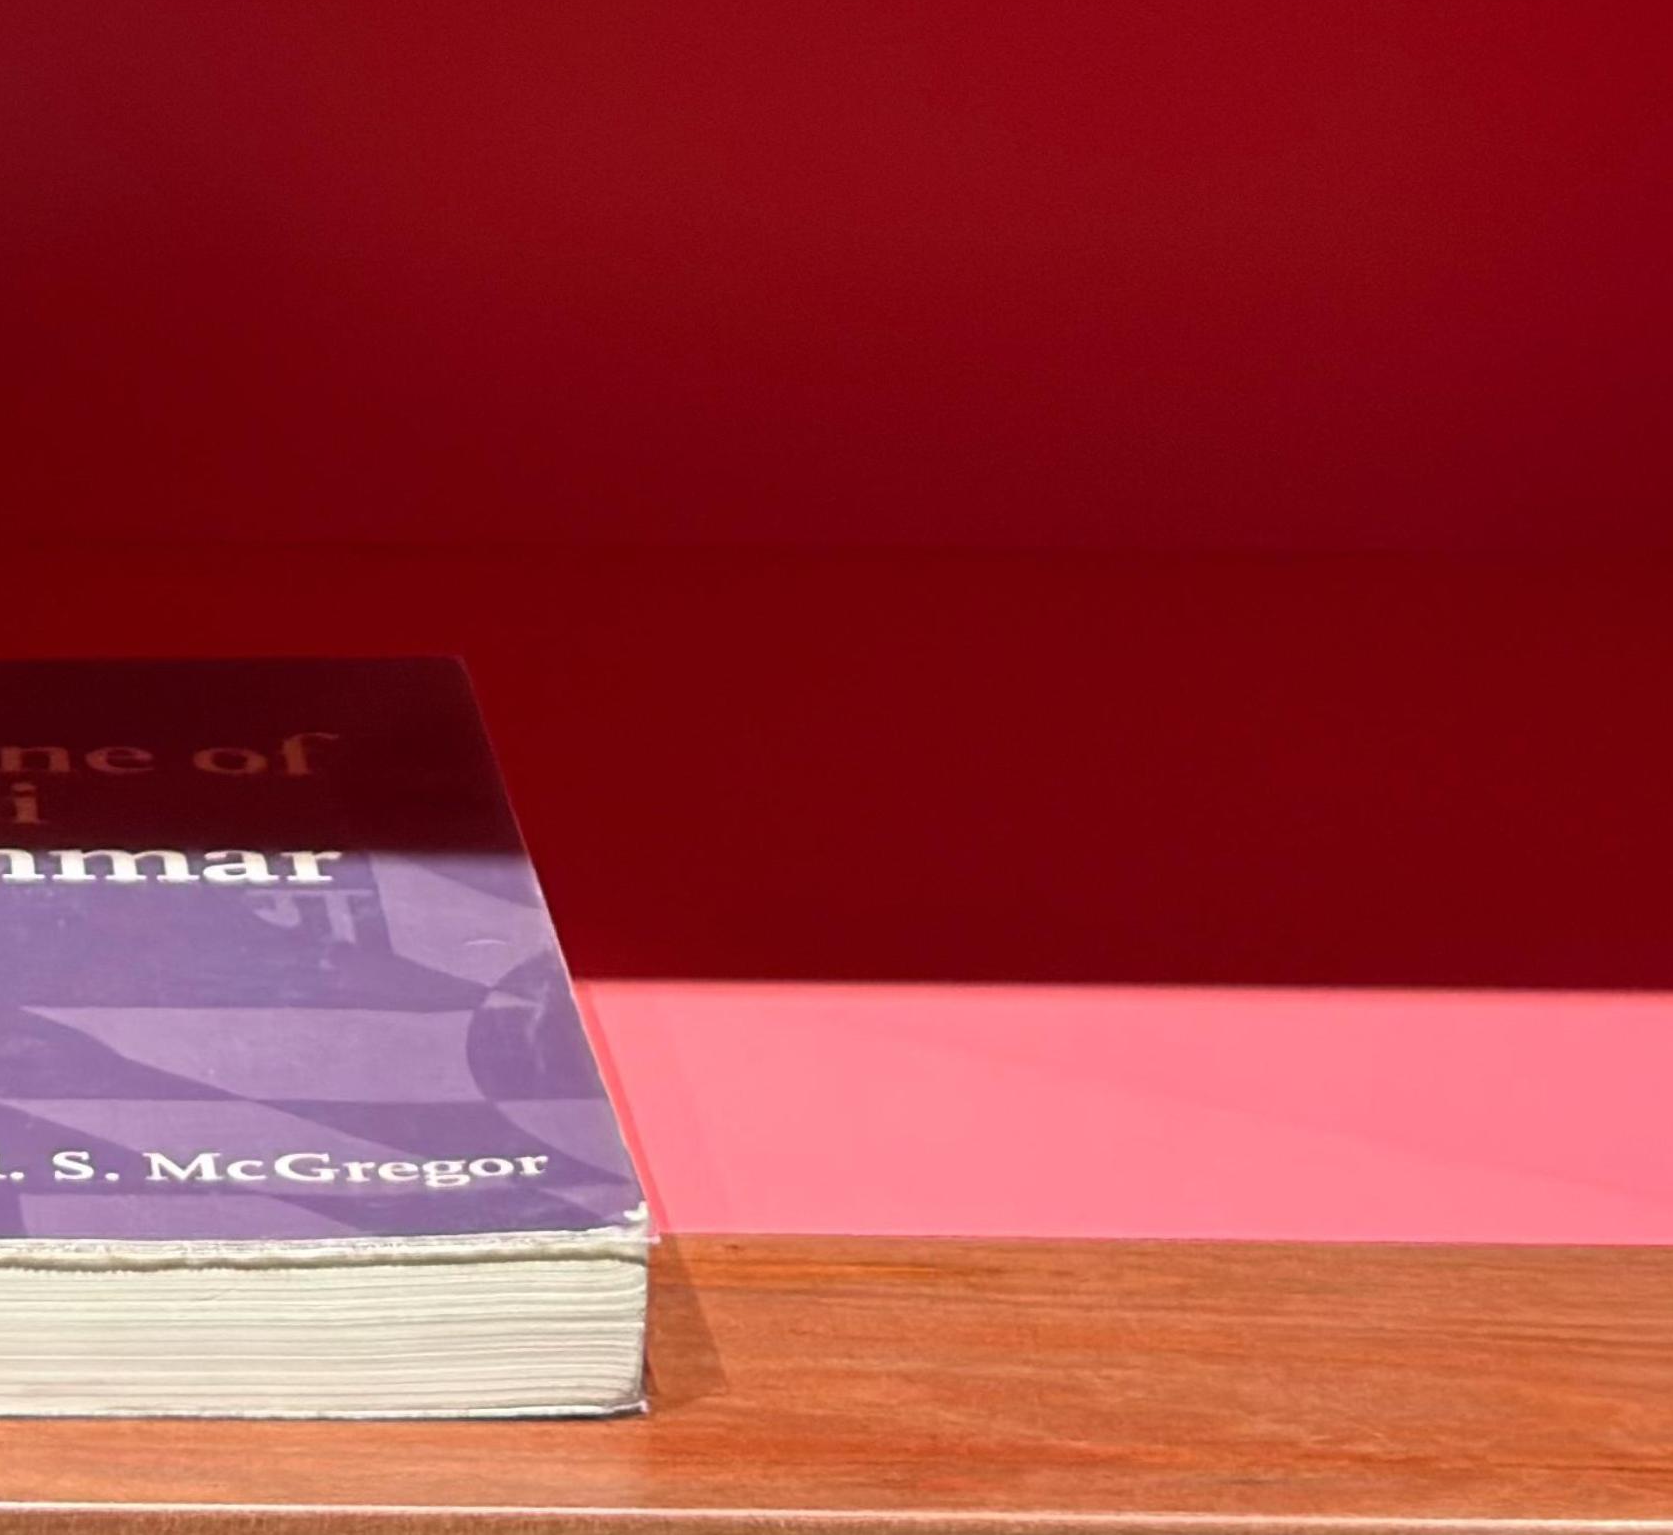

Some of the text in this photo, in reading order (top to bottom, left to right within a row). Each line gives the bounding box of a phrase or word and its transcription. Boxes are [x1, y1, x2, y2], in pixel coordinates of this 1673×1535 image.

[192, 731, 342, 778] of
[52, 1149, 122, 1182] S.
[142, 1151, 550, 1190] McGregor
